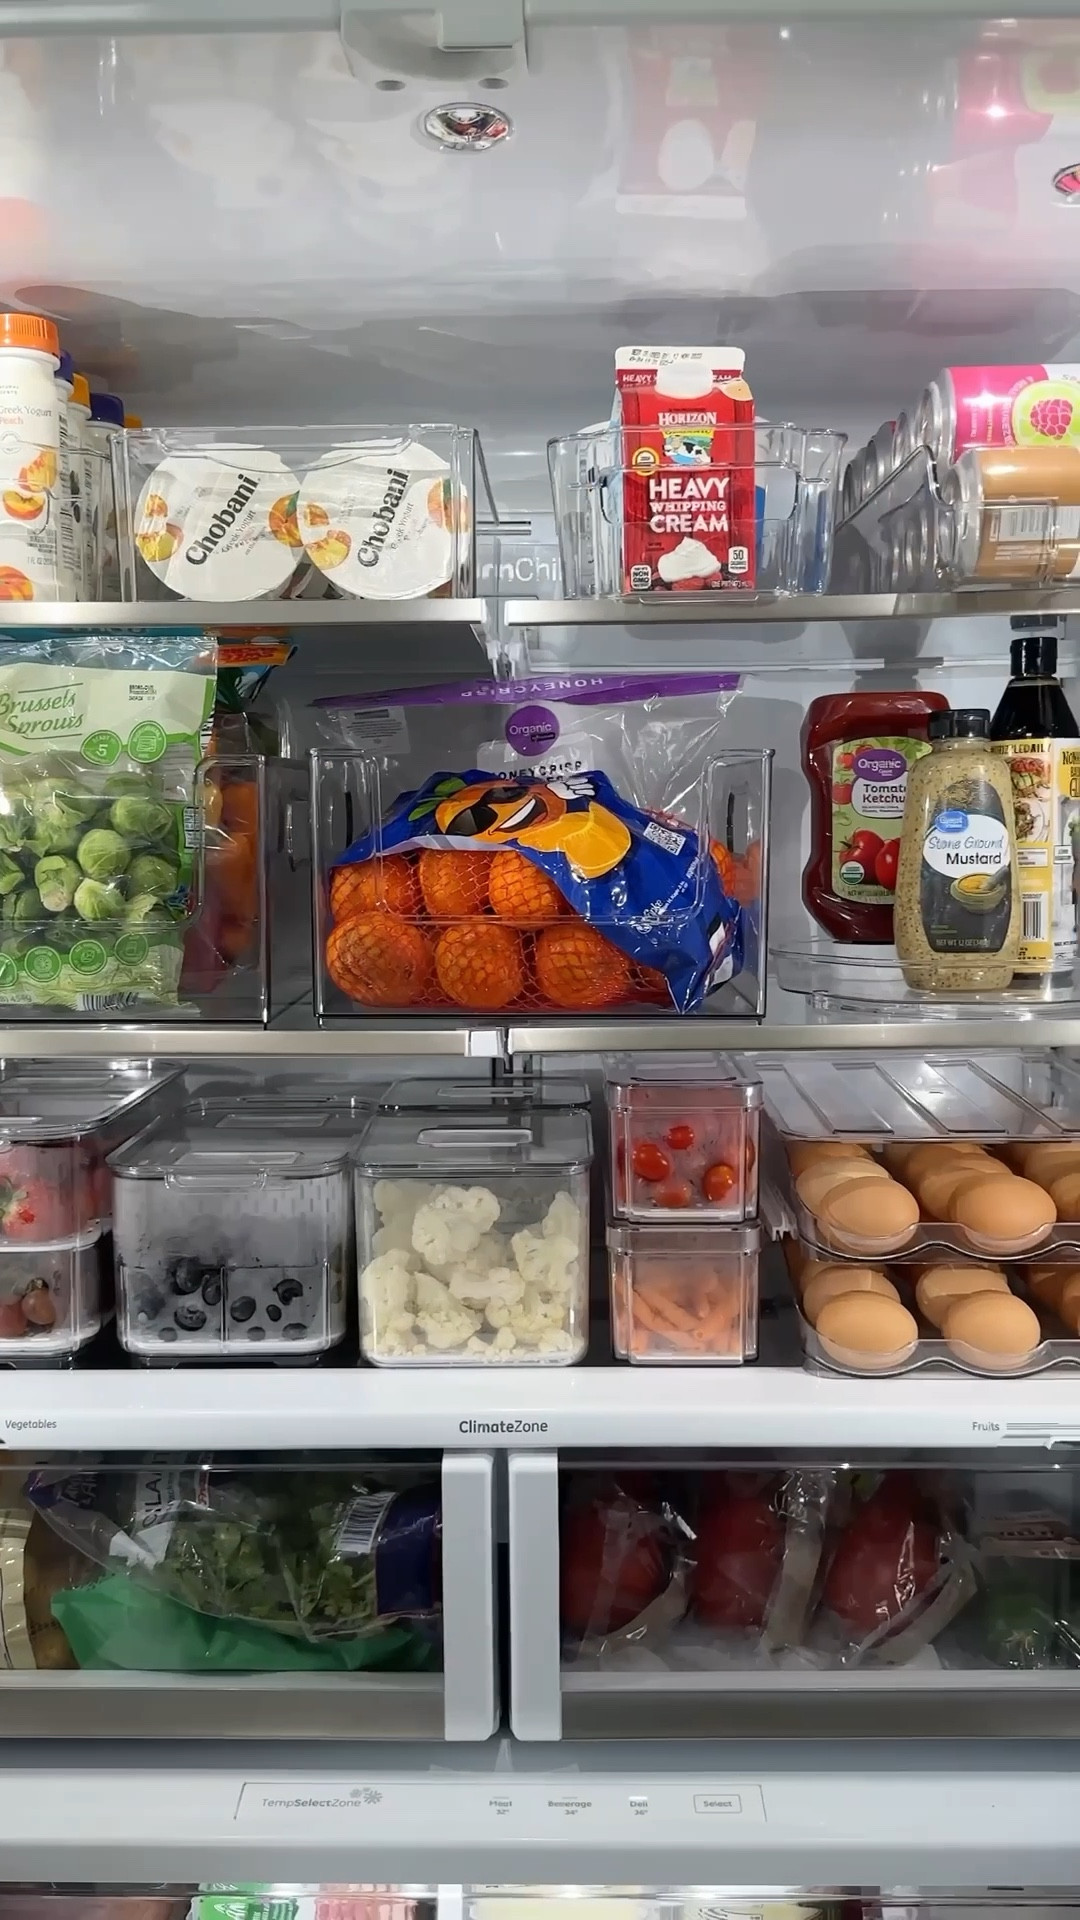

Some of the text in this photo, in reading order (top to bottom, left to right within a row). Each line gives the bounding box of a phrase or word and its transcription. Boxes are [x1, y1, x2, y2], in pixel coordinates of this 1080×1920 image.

[658, 412, 717, 426] HORIZON
[649, 477, 730, 500] HEAVY
[649, 501, 727, 514] WHIPPING
[185, 473, 259, 566] Chobani
[357, 468, 409, 568] Chobani
[649, 514, 729, 534] CREAM
[732, 549, 745, 560] 50
[461, 678, 604, 697] HONEYCRISP
[0, 688, 76, 715] Brussels
[8, 713, 84, 736] Sprouts
[509, 721, 552, 736] Organic
[95, 743, 109, 757] 5
[498, 760, 582, 781] ONEYCRISP
[857, 758, 901, 772] Organic
[863, 783, 907, 793] Tomat
[862, 793, 906, 804] Ketchu
[928, 835, 1005, 850] Stone Ground
[946, 851, 1002, 865] Mustard
[5, 1419, 57, 1431] Vegetables
[459, 1419, 549, 1434] ClimateZone
[972, 1421, 1000, 1431] Fruits
[261, 1797, 361, 1809] TempSelectZone
[547, 1800, 592, 1809] Beverage
